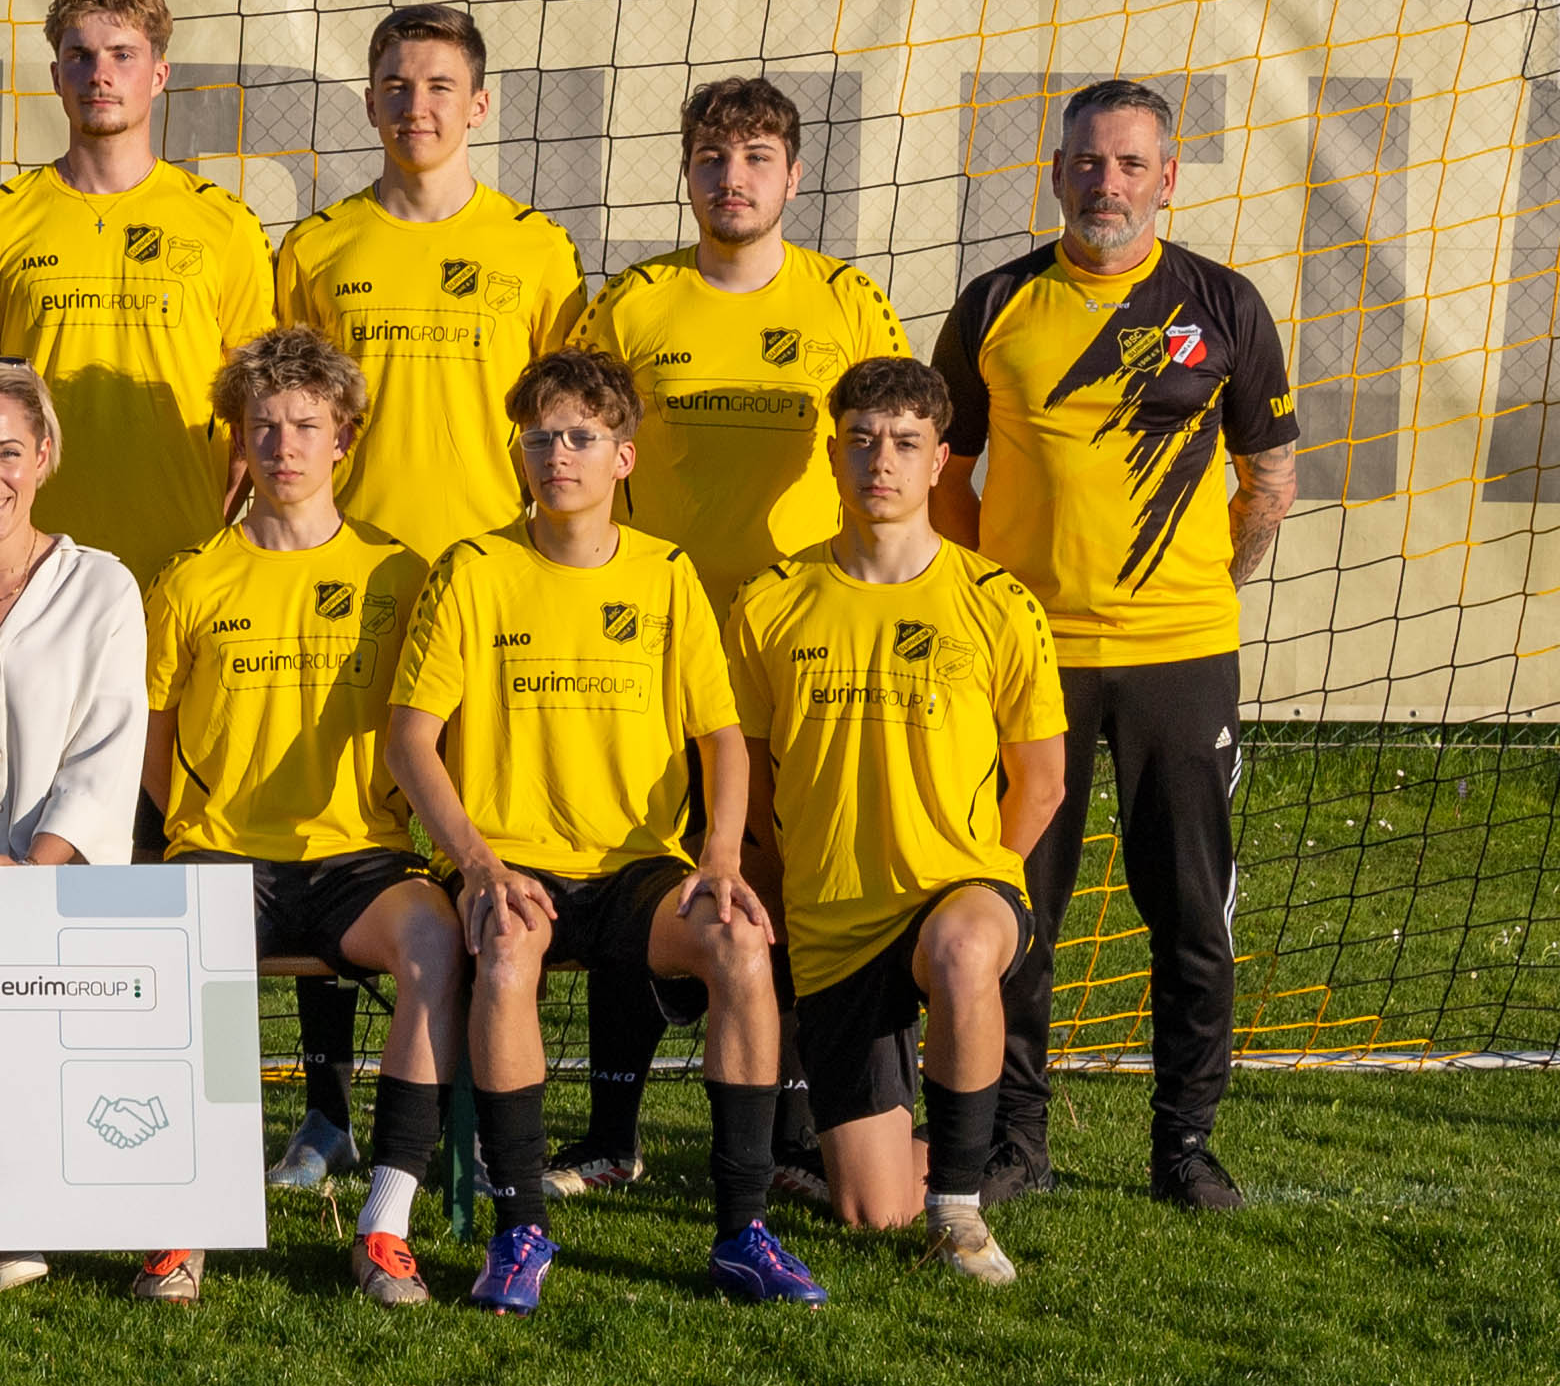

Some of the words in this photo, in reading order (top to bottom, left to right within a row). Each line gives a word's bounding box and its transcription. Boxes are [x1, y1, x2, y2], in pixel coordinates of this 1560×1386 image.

[21, 255, 59, 270] JAKO
[335, 281, 372, 297] JAKO
[41, 288, 157, 310] eurimGROUP
[352, 320, 469, 342] eurimGROUP
[654, 352, 692, 366] JAKO
[666, 390, 793, 413] eurimGROUP
[211, 618, 251, 634] JAKO
[492, 633, 531, 648] JAKO
[232, 650, 350, 674] eurimGROUP
[792, 646, 829, 662] JAKO
[513, 670, 634, 694] eurimGROUP
[812, 682, 923, 709] eurimGROUP
[1, 976, 128, 998] eurimGROUP
[591, 1069, 636, 1083] JAKO
[783, 1079, 808, 1090] JA
